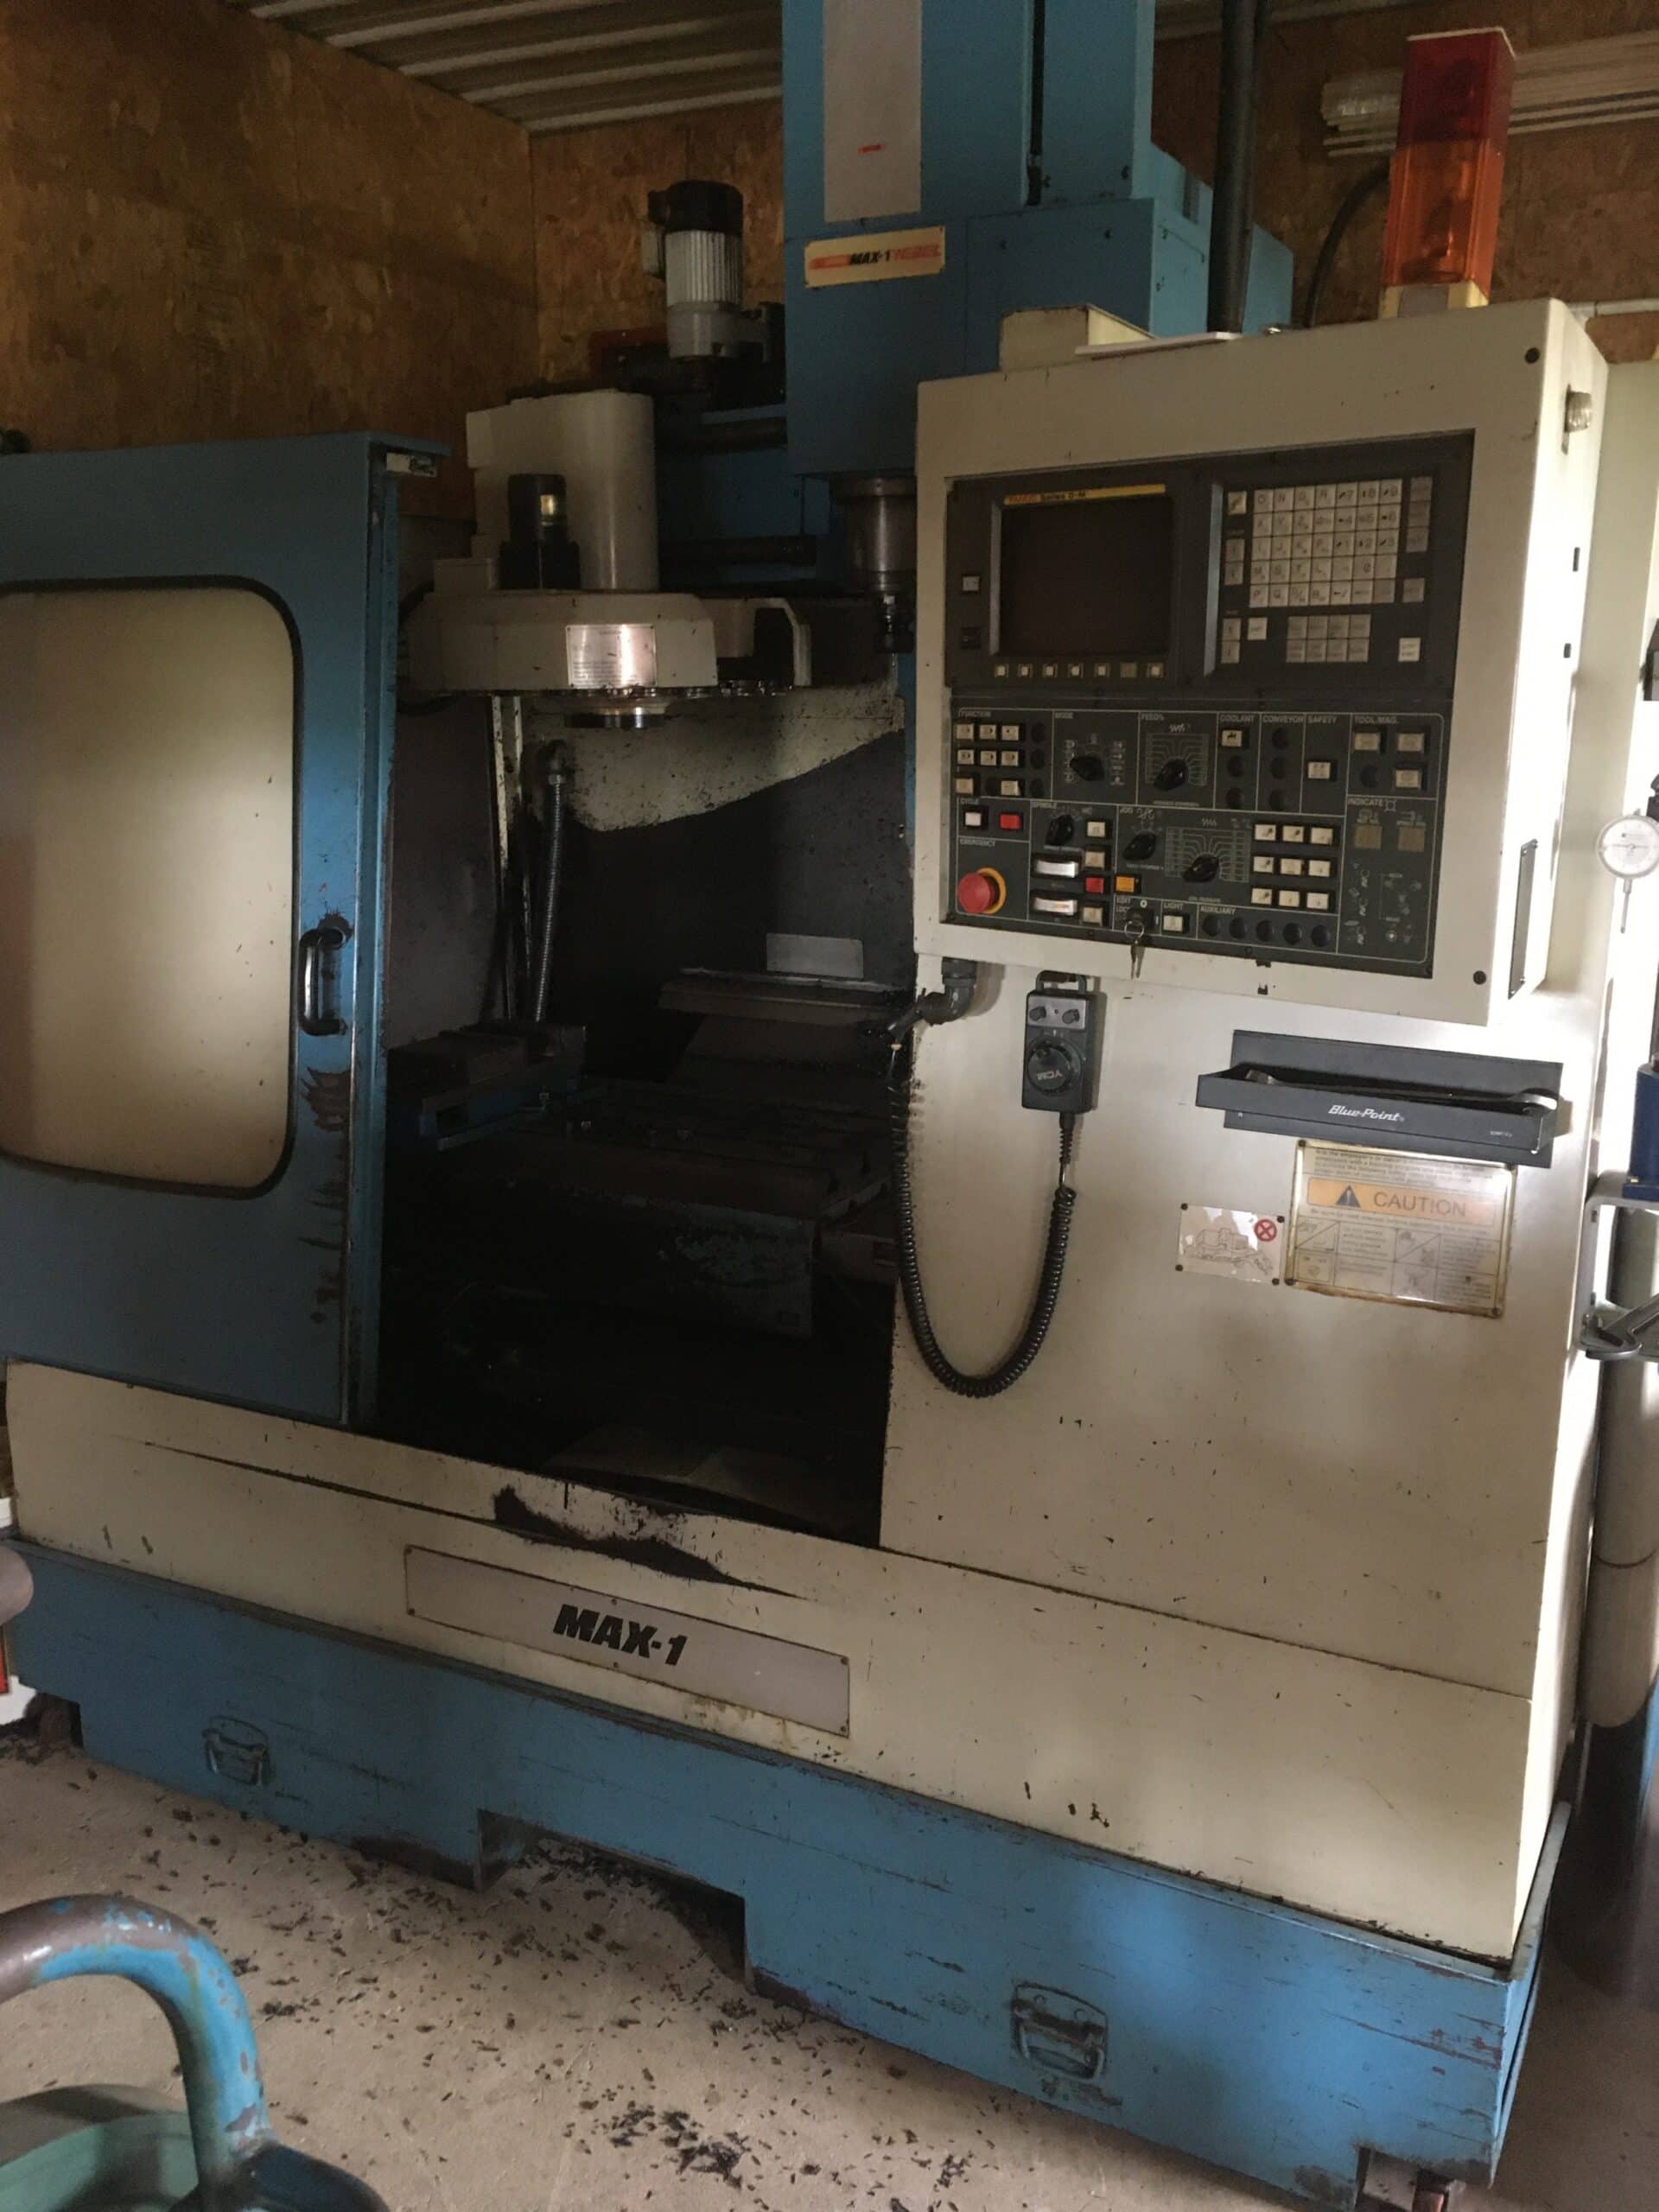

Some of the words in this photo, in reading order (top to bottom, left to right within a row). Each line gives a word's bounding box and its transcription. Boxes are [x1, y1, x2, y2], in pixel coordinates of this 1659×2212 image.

[849, 250, 891, 265] MAX-1
[1220, 715, 1255, 723] COOLANT
[1262, 715, 1304, 723] CONVEYOR
[1307, 715, 1338, 724] SAFETY
[1348, 797, 1383, 807] INDICATE
[1200, 905, 1236, 914] AUXILIARY
[1373, 1191, 1466, 1217] CAUTION
[553, 1604, 688, 1666] MAX-1
